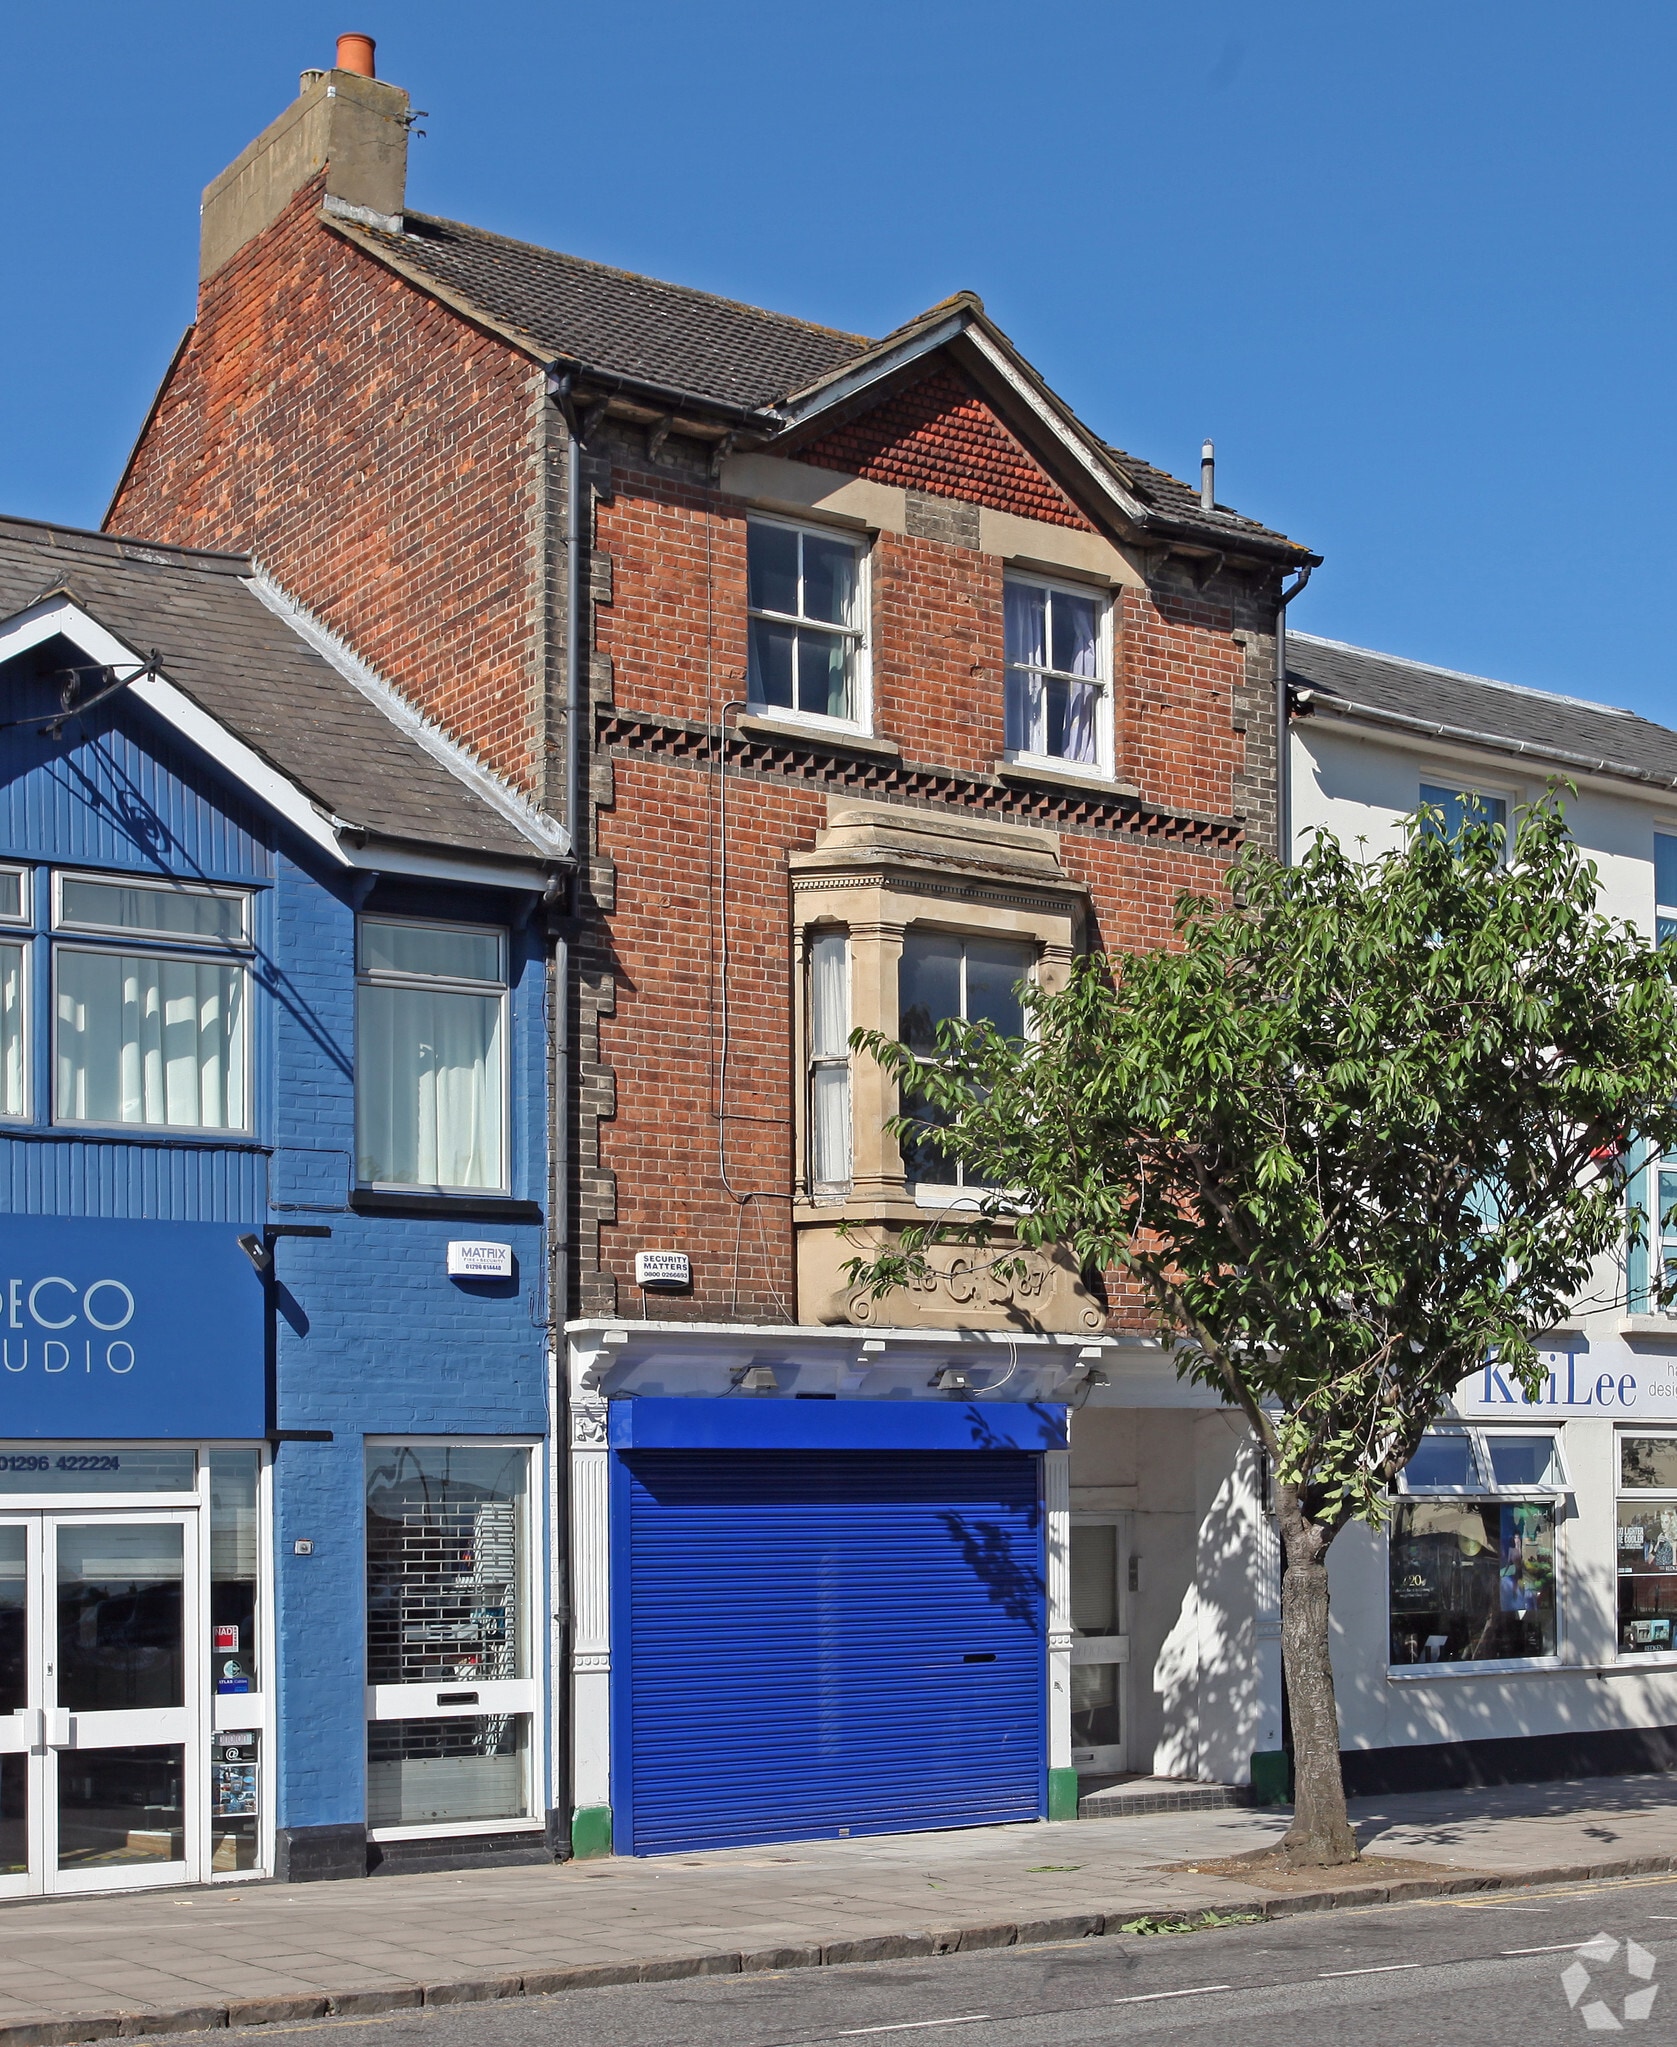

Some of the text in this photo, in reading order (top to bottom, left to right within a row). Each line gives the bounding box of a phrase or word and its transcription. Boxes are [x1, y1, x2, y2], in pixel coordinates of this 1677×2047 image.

[462, 1247, 506, 1259] MATRIX
[643, 1255, 687, 1263] SECURITY
[0, 1276, 135, 1331] ECO
[0, 1456, 120, 1471] 01296 422224
